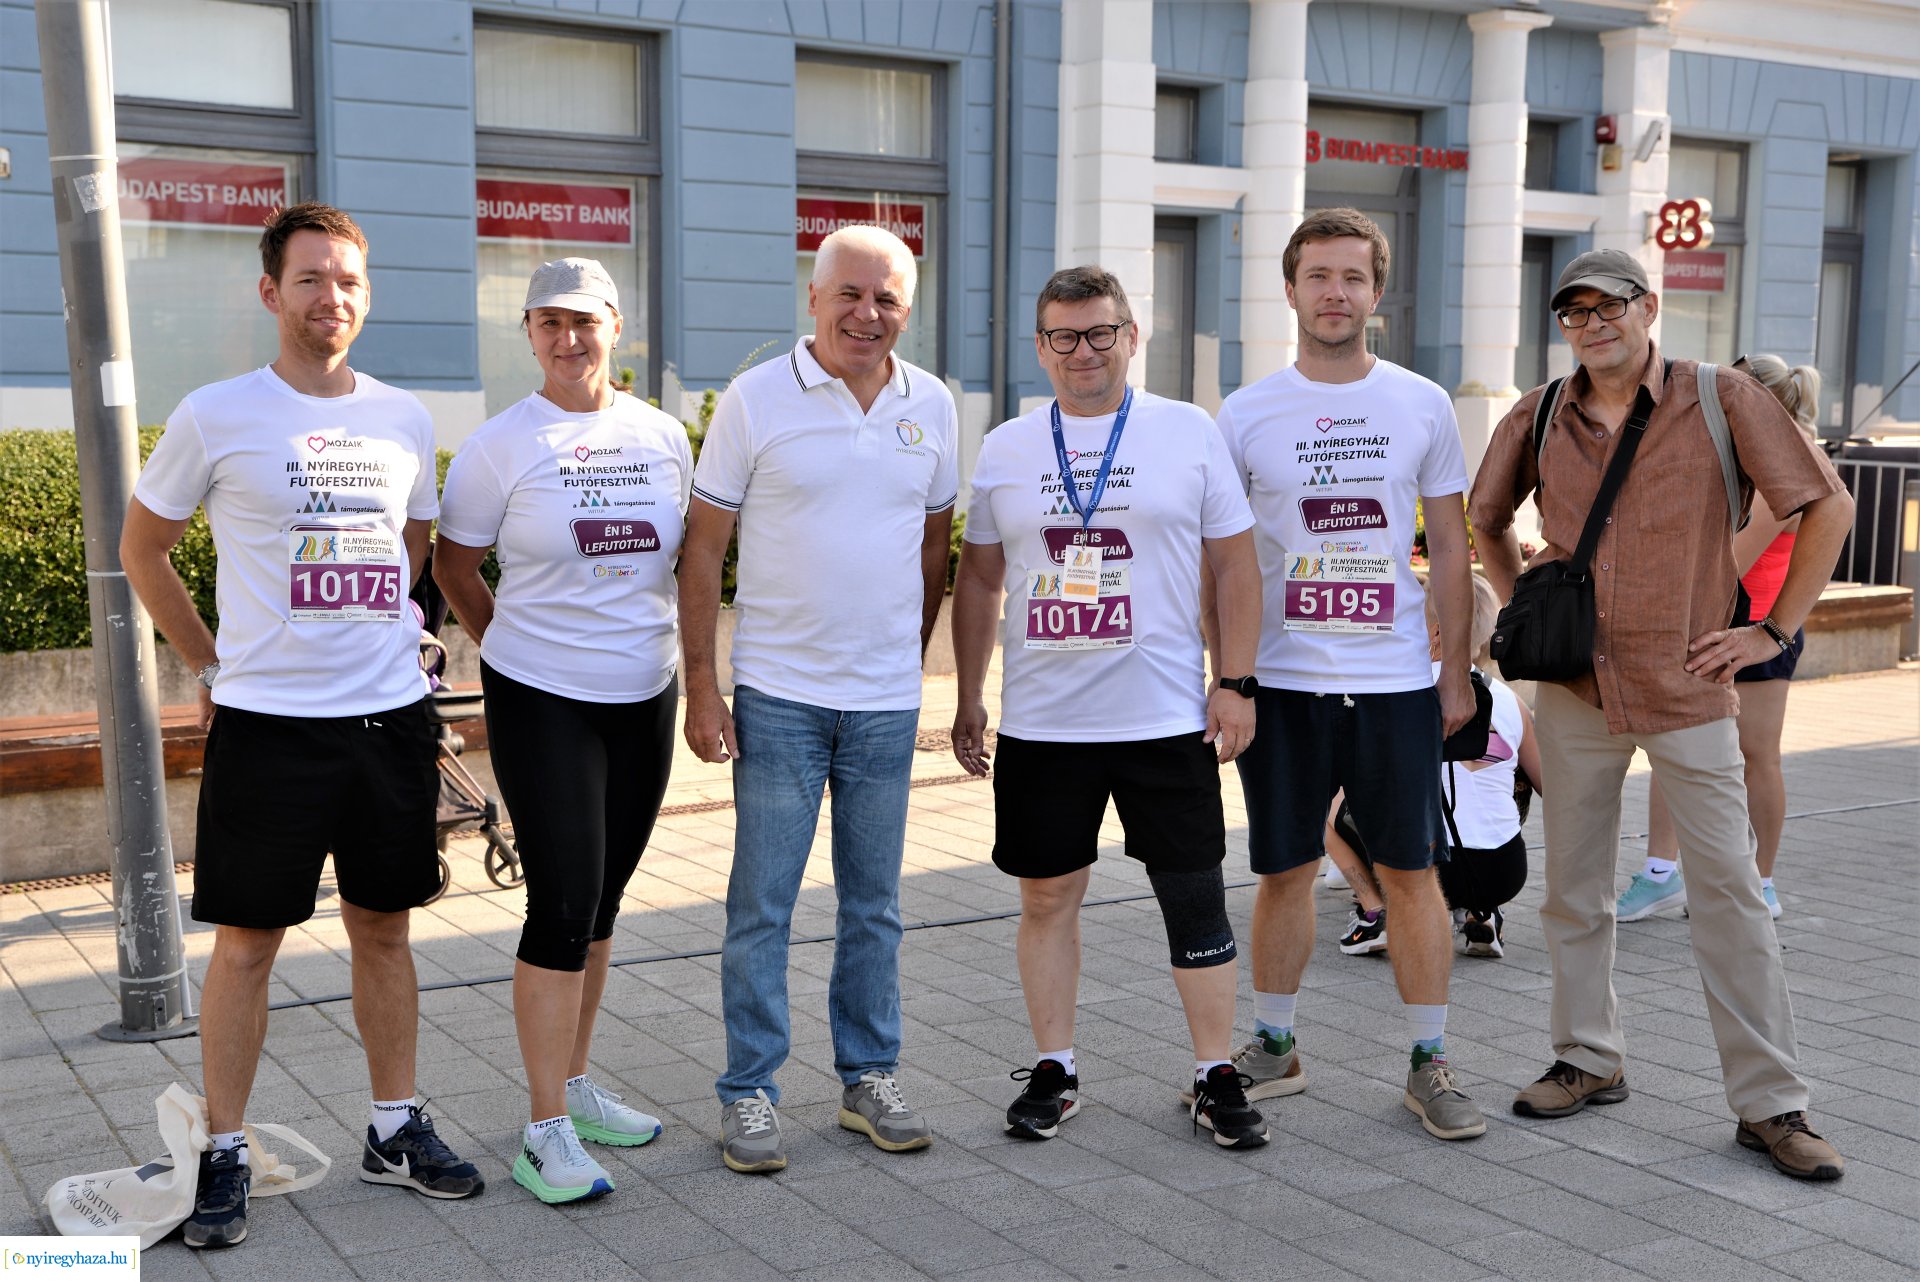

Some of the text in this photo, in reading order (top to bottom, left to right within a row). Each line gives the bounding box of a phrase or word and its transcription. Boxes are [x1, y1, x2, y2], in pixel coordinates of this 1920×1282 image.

[117, 178, 284, 207] UDAPEST BANK
[476, 199, 631, 226] BUDAPEST BANK
[1333, 418, 1366, 426] MOZAIK
[327, 440, 362, 448] MOZAIK
[1296, 435, 1390, 451] III. NYÍREGYHÁZI
[590, 448, 622, 456] MOZAIK
[1298, 448, 1387, 463] FUTÓFESZTIVÁL
[287, 459, 390, 473] III. NYÍREGYHÁZI
[560, 463, 649, 476] III. NYÍREGYHÁZI
[1041, 465, 1135, 482] III. YÍREGHÁZI
[1342, 476, 1385, 484] támogatásával
[290, 474, 390, 488] FUTÓFESZTIVÁL
[564, 475, 651, 488] FUTÓFESZTIVÁL
[1330, 502, 1359, 514] ÉN IS
[1311, 515, 1382, 530] LEFUTOTTAM
[605, 524, 633, 536] ÉN IS
[1091, 533, 1102, 543] IS
[585, 538, 656, 554] LEFUTOTTAM
[1331, 565, 1388, 574] FUTÓFESZTIVÁL
[296, 570, 398, 603] 10175
[1299, 587, 1380, 617] 5195
[1031, 602, 1129, 634] 10174
[1192, 940, 1234, 958] MUELLER
[524, 1144, 544, 1175] HOKA
